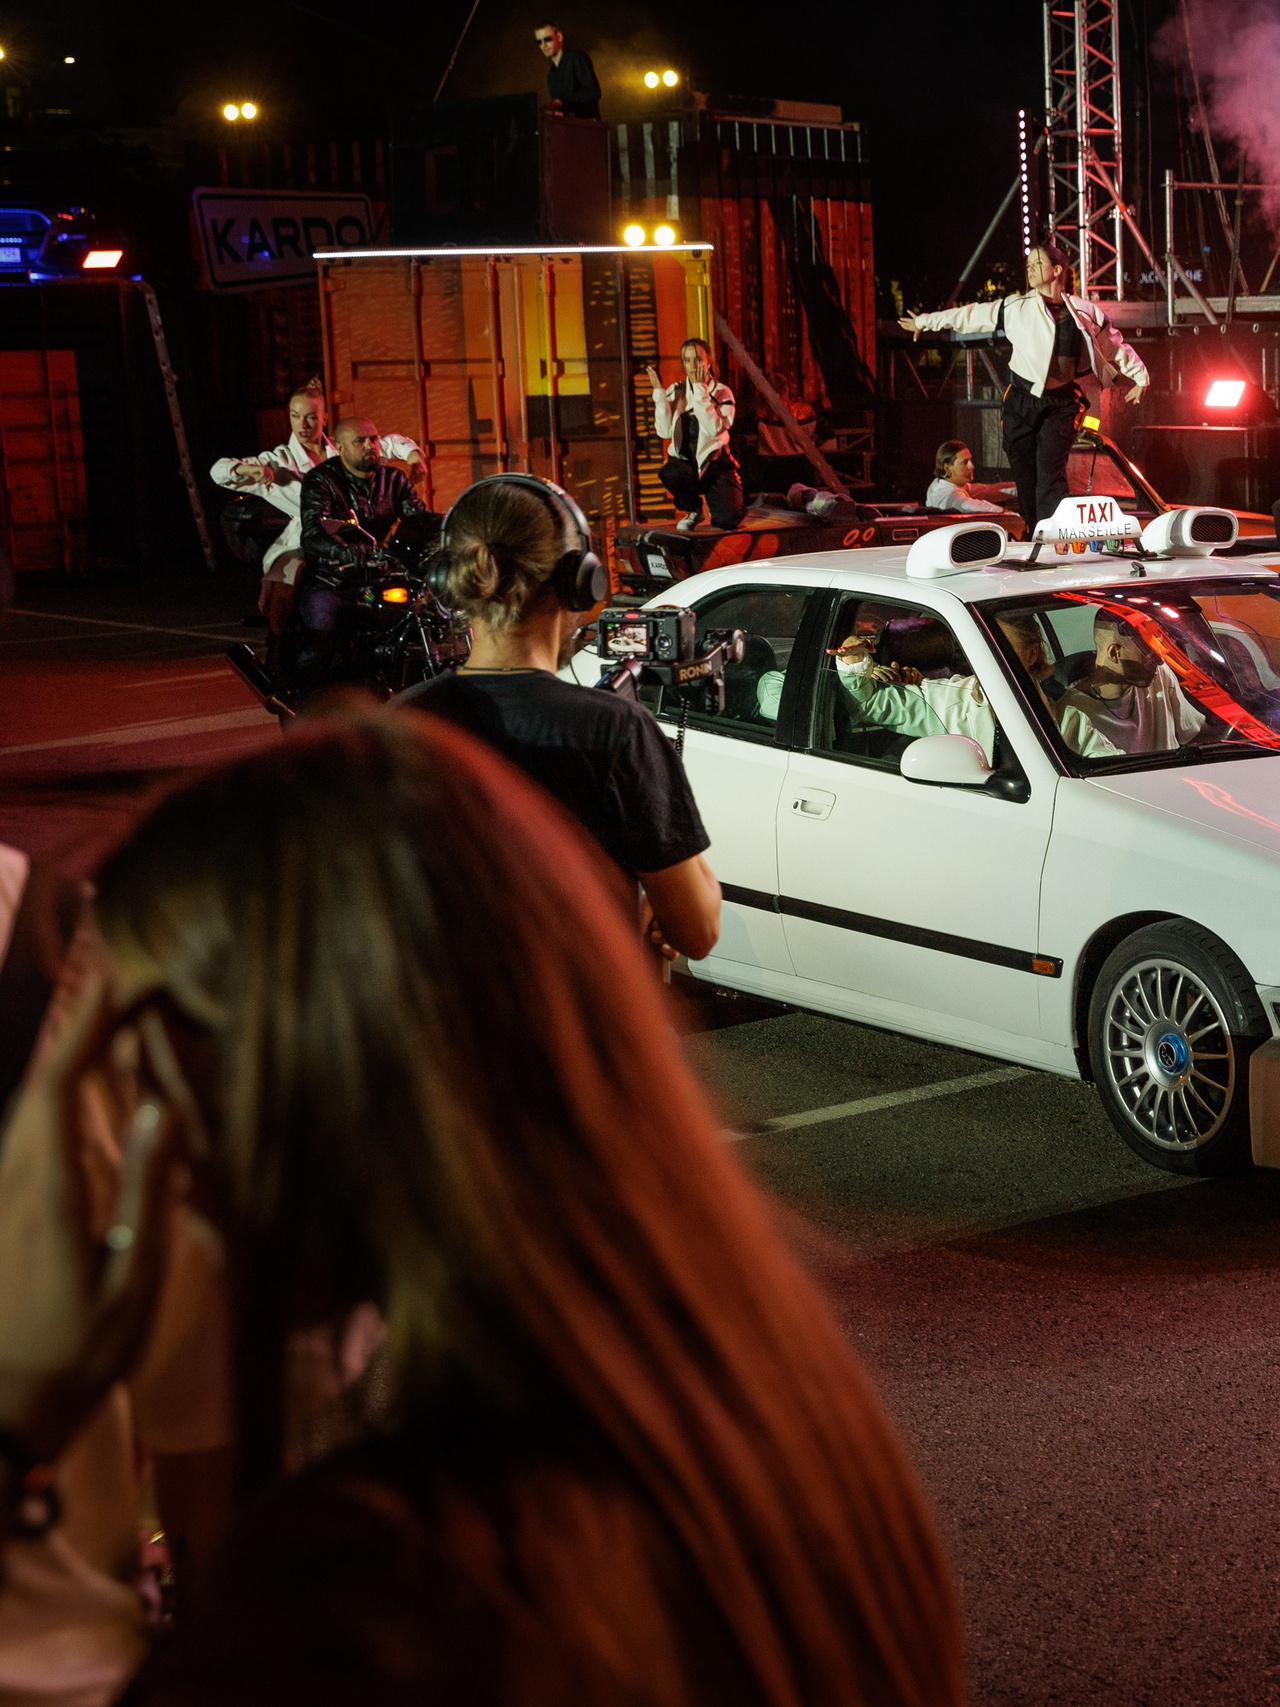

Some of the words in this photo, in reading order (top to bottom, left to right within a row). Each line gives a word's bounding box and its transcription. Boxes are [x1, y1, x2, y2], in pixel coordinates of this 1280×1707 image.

[210, 215, 367, 264] KARDO
[1076, 502, 1114, 524] TAXI
[1058, 522, 1132, 540] MARSEILLE
[679, 661, 712, 680] RONIN
